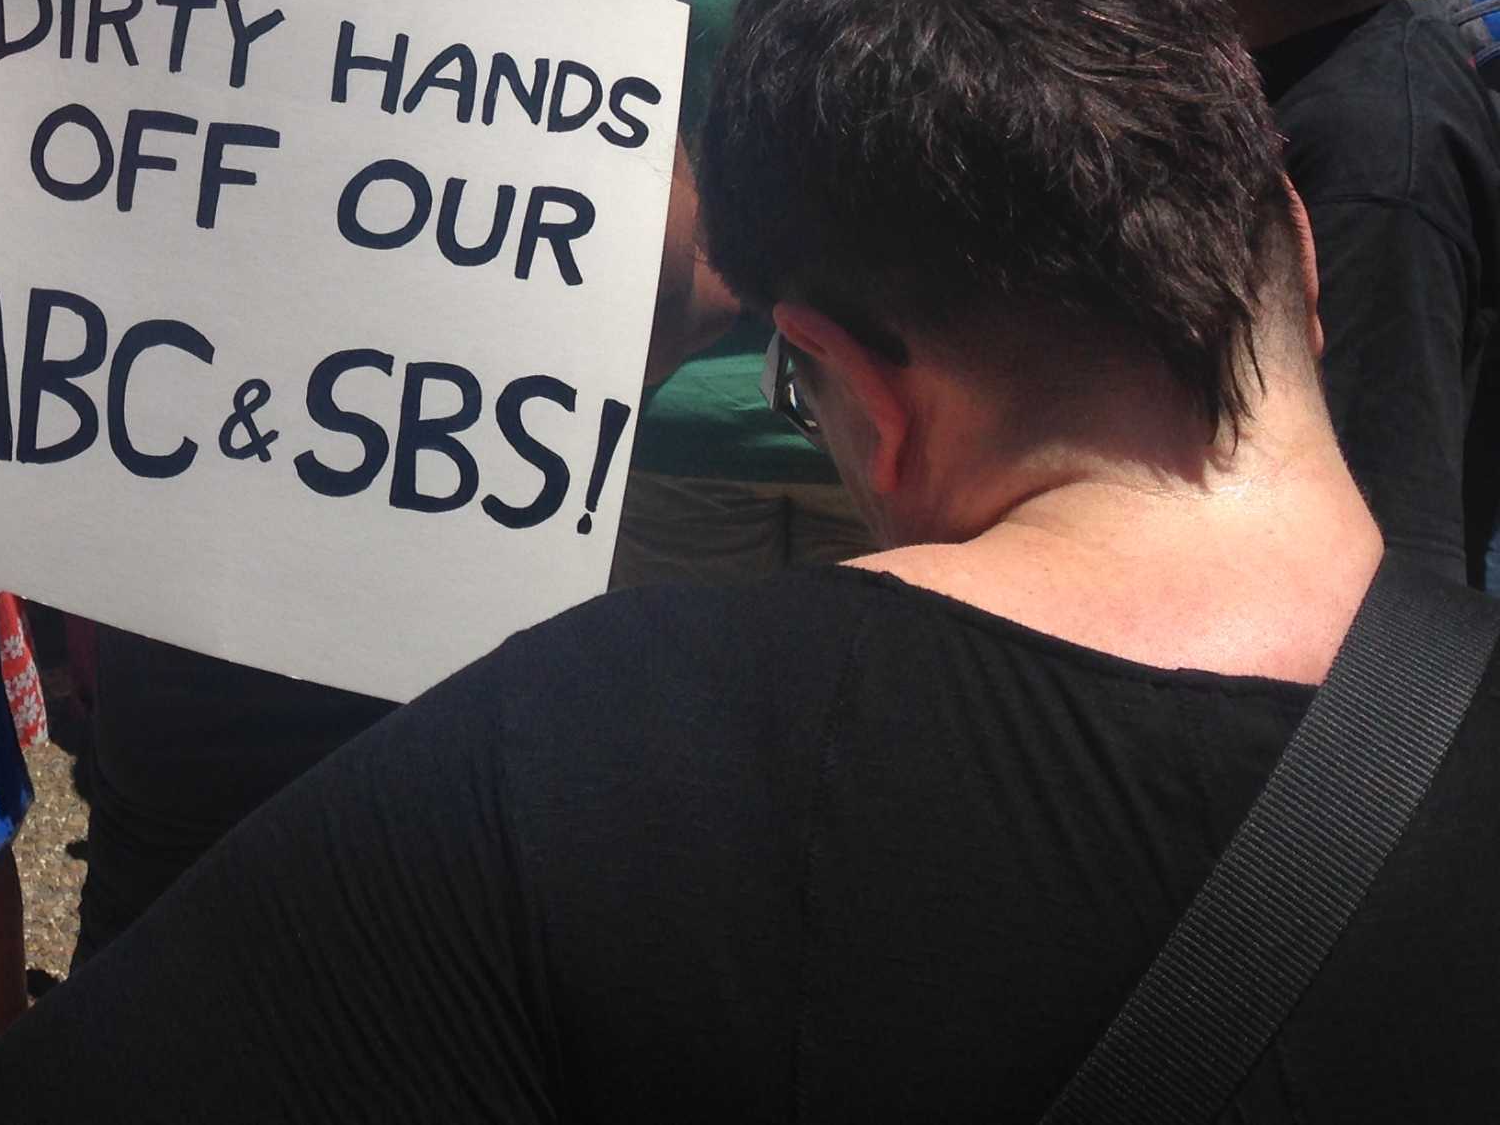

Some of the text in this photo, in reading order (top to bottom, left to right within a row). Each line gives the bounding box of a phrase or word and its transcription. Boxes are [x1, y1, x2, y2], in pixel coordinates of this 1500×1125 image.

[331, 21, 661, 148] HANDS
[30, 103, 595, 285] OFF OUR
